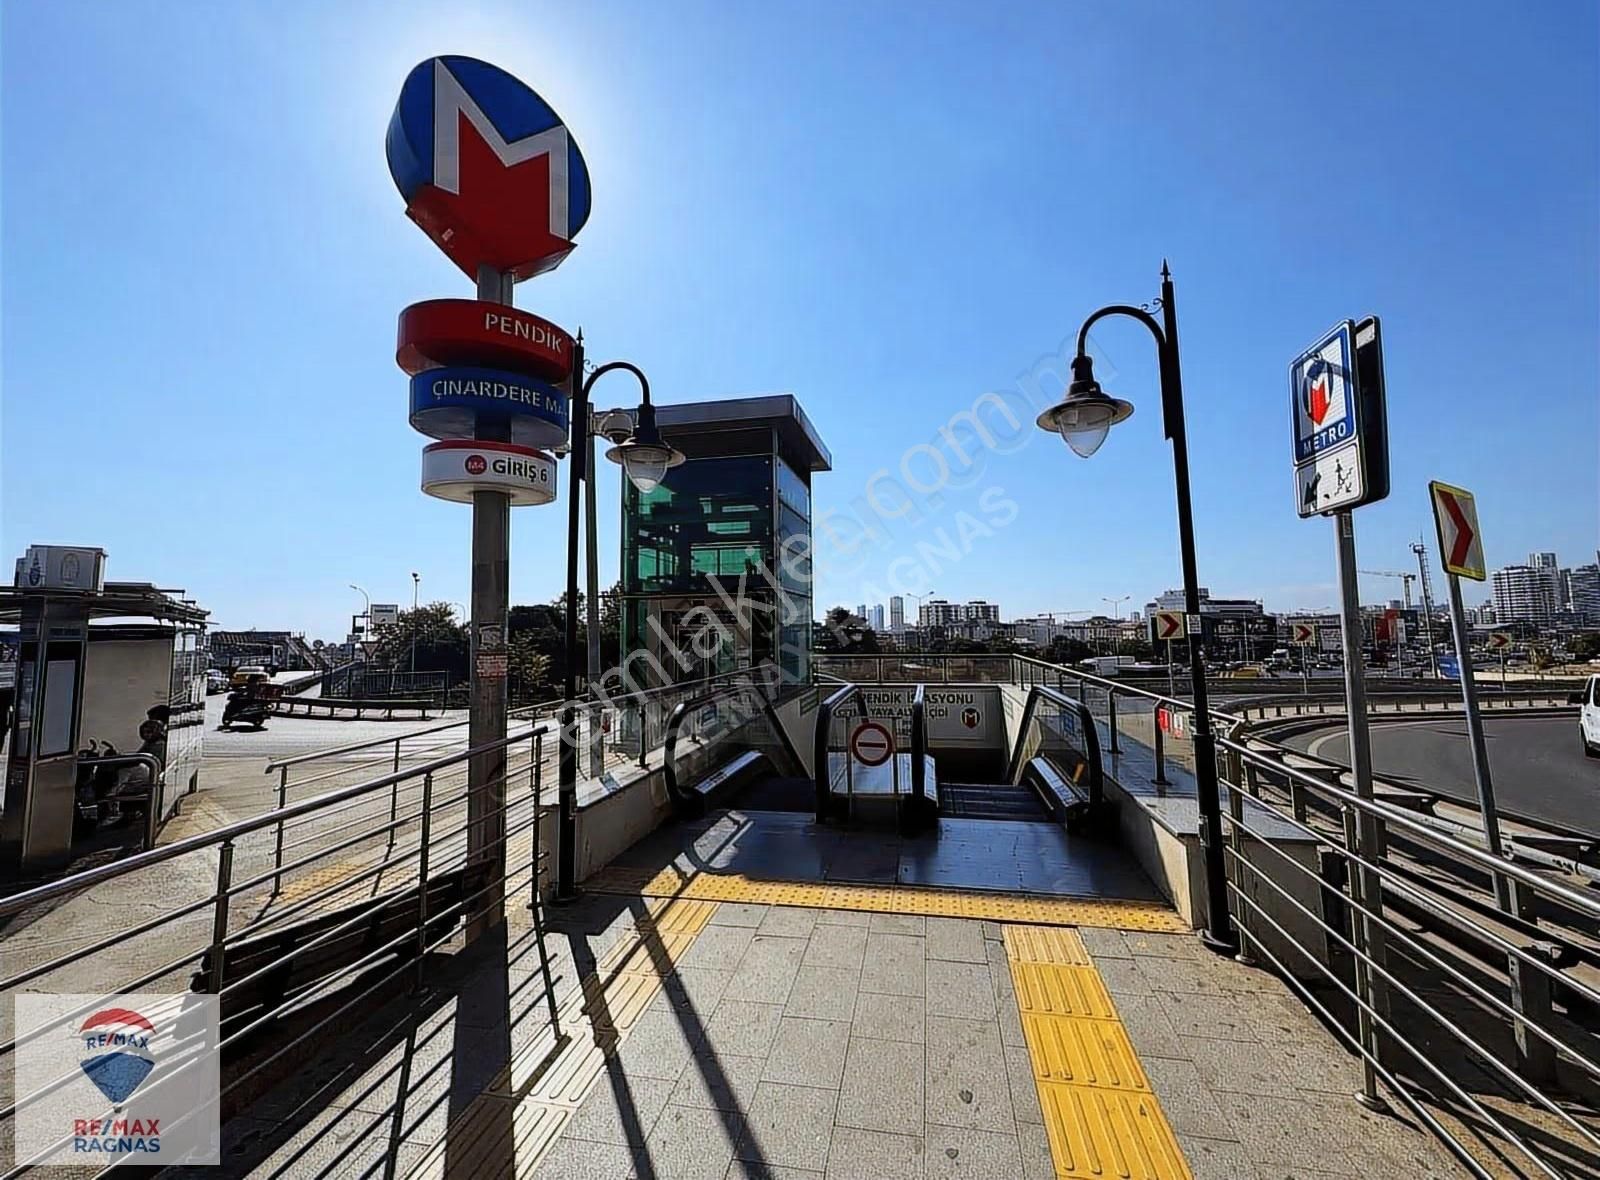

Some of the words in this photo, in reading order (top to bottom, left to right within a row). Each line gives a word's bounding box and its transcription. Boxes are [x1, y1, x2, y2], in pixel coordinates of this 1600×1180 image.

[484, 312, 562, 353] PENDİK
[432, 379, 541, 407] ÇINARDERE
[1303, 421, 1347, 455] METRO
[492, 457, 537, 482] GİRİŞ
[540, 467, 548, 483] 6
[869, 705, 894, 717] YAYA
